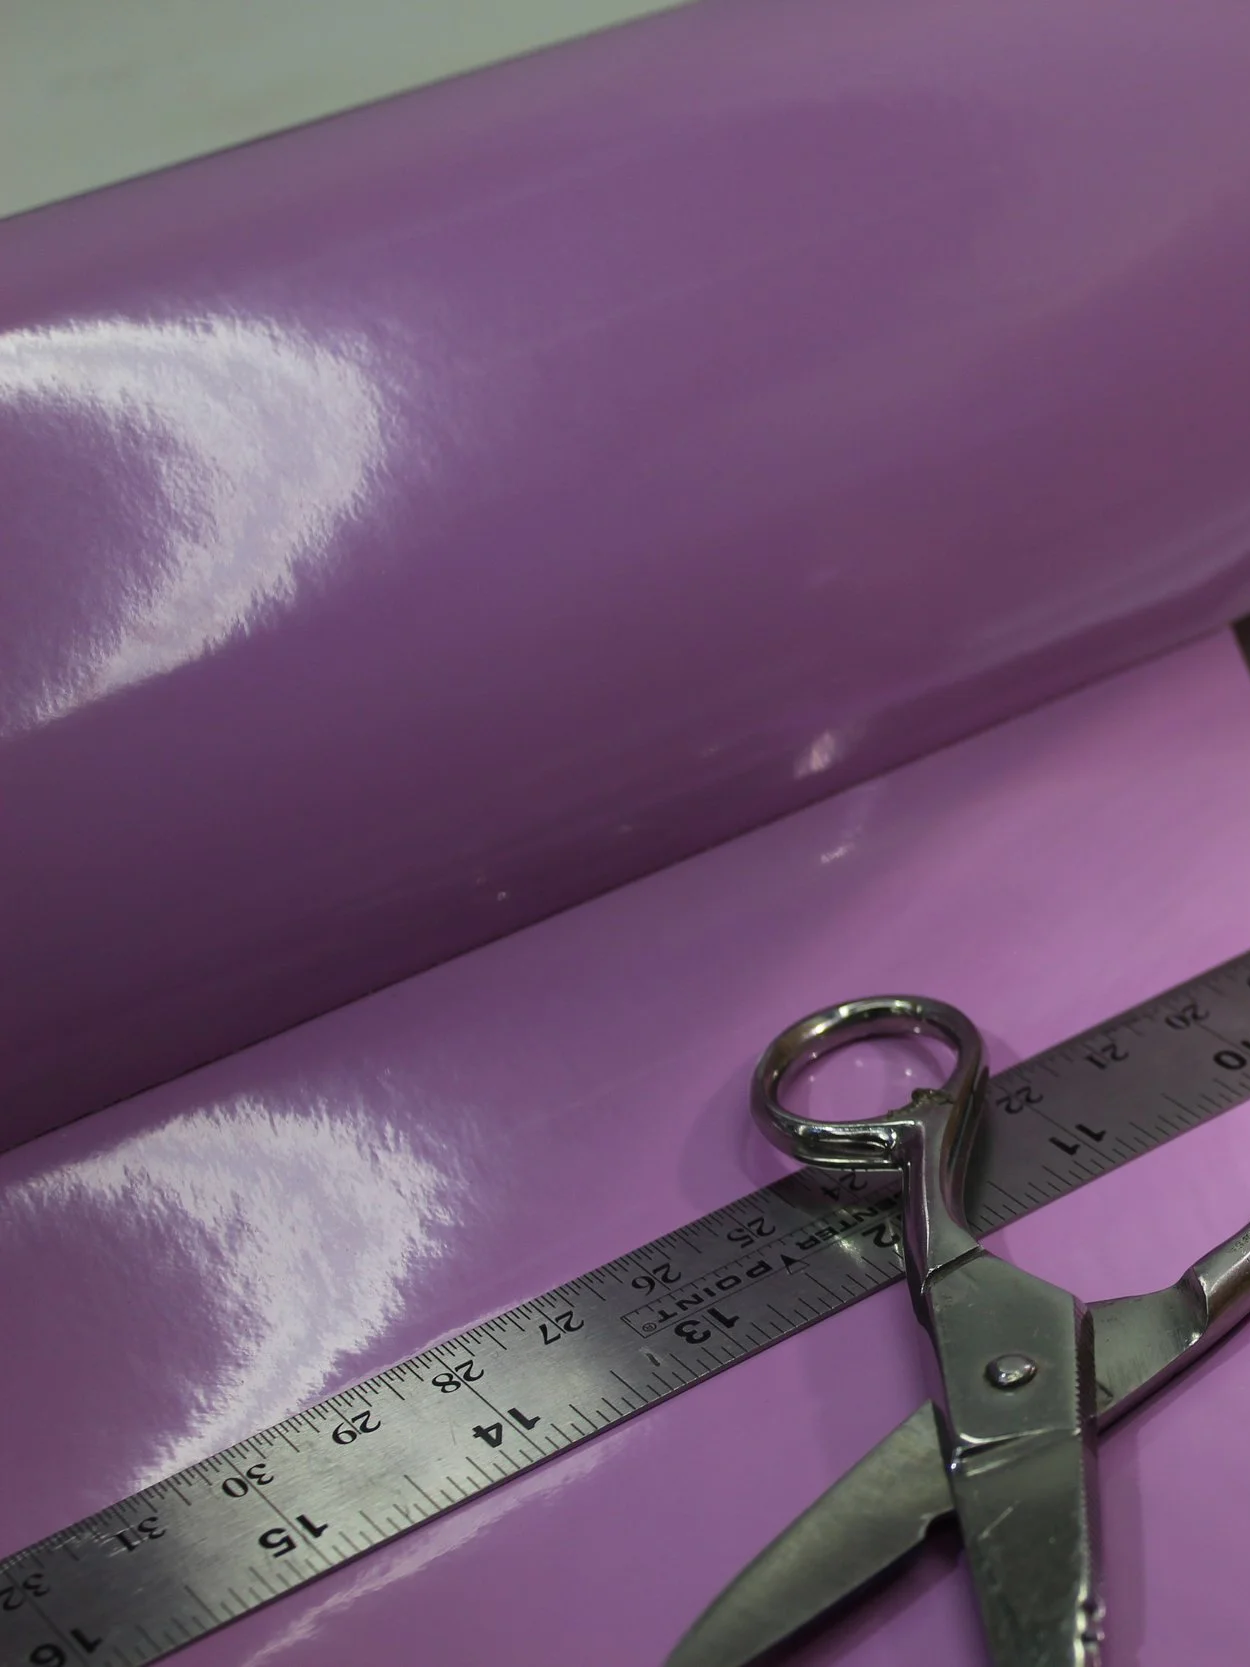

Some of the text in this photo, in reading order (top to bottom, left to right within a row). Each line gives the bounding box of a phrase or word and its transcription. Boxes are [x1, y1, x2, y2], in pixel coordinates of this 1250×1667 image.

[1165, 1004, 1211, 1031] 20
[1086, 1042, 1130, 1071] 21
[996, 1085, 1044, 1115] 22
[1048, 1122, 1107, 1157] 11
[821, 1172, 868, 1202] 24
[726, 1216, 776, 1249] 25
[796, 1195, 901, 1250] ENTER
[861, 1213, 902, 1248] 2
[631, 1262, 682, 1295] 26
[537, 1310, 585, 1346] 27
[674, 1306, 741, 1347] 13
[431, 1359, 485, 1394] 28
[331, 1410, 382, 1446] 29
[471, 1407, 542, 1449] 14
[221, 1463, 274, 1499] 30
[108, 1516, 167, 1553] 31
[257, 1513, 329, 1557] 15
[0, 1573, 51, 1611] 32
[29, 1628, 103, 1667] 16
